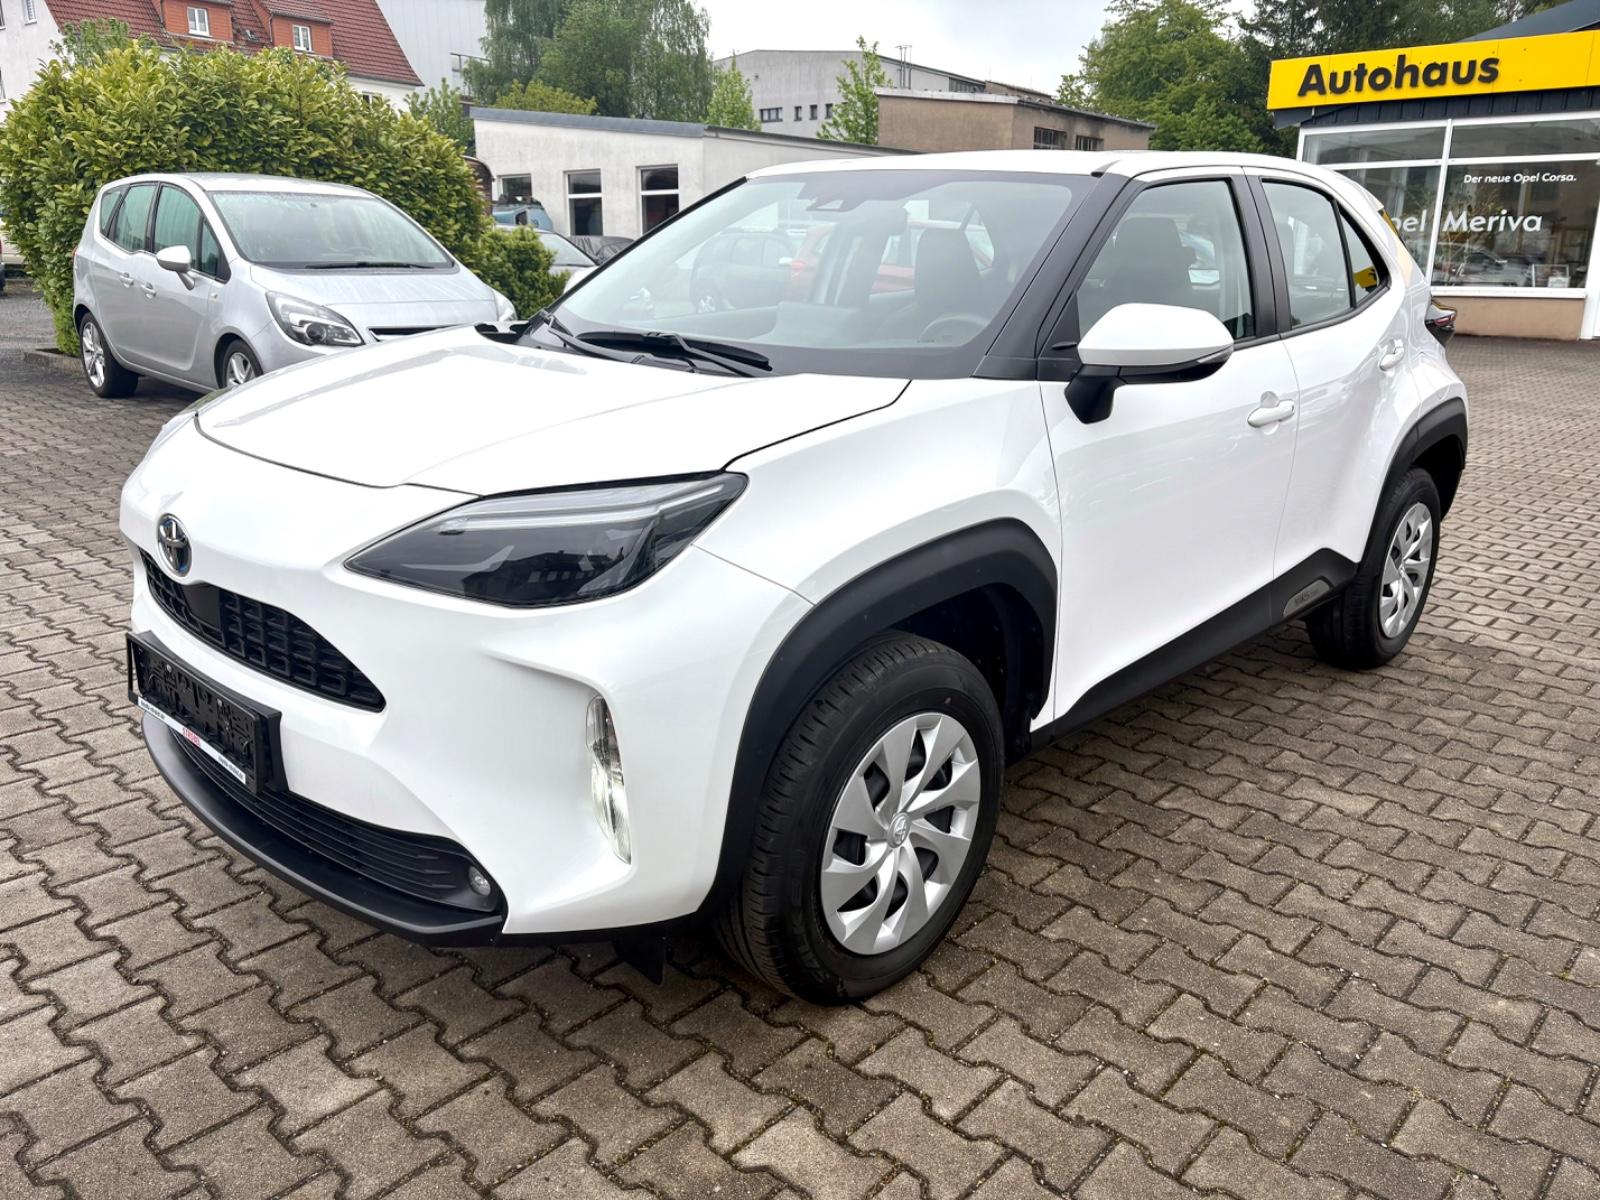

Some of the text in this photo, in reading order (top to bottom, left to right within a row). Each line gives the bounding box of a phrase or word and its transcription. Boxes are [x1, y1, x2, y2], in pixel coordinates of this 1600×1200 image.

[1297, 54, 1500, 96] Autohaus
[1464, 172, 1577, 184] Der neue Opel Corsa.
[1442, 209, 1543, 232] Meriva
